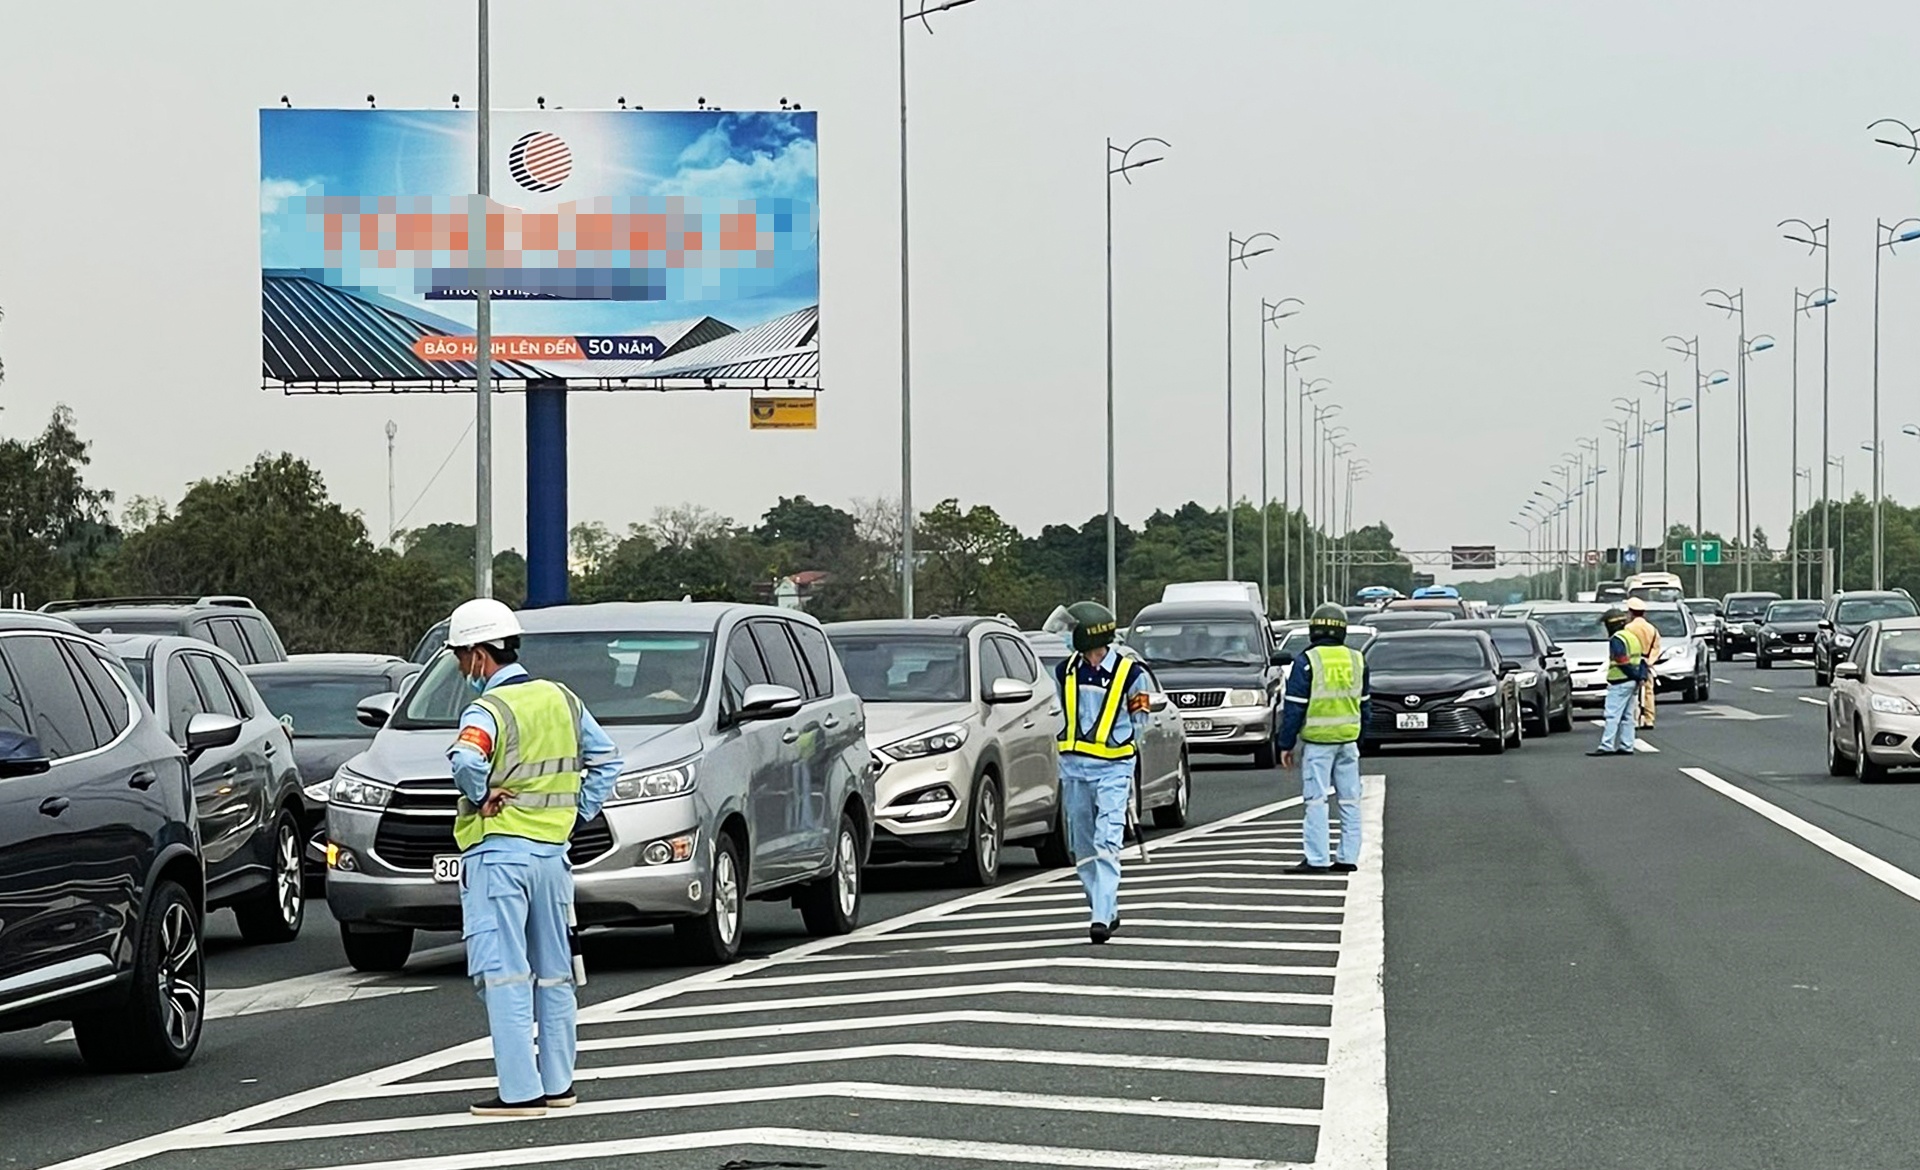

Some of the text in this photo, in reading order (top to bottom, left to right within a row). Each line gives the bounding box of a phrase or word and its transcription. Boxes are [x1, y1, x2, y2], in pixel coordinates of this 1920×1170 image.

[425, 339, 458, 355] BẢO
[510, 339, 540, 355] LÊN
[544, 338, 577, 355] ĐẾN
[588, 339, 614, 355] 50
[618, 341, 654, 355] NĂM
